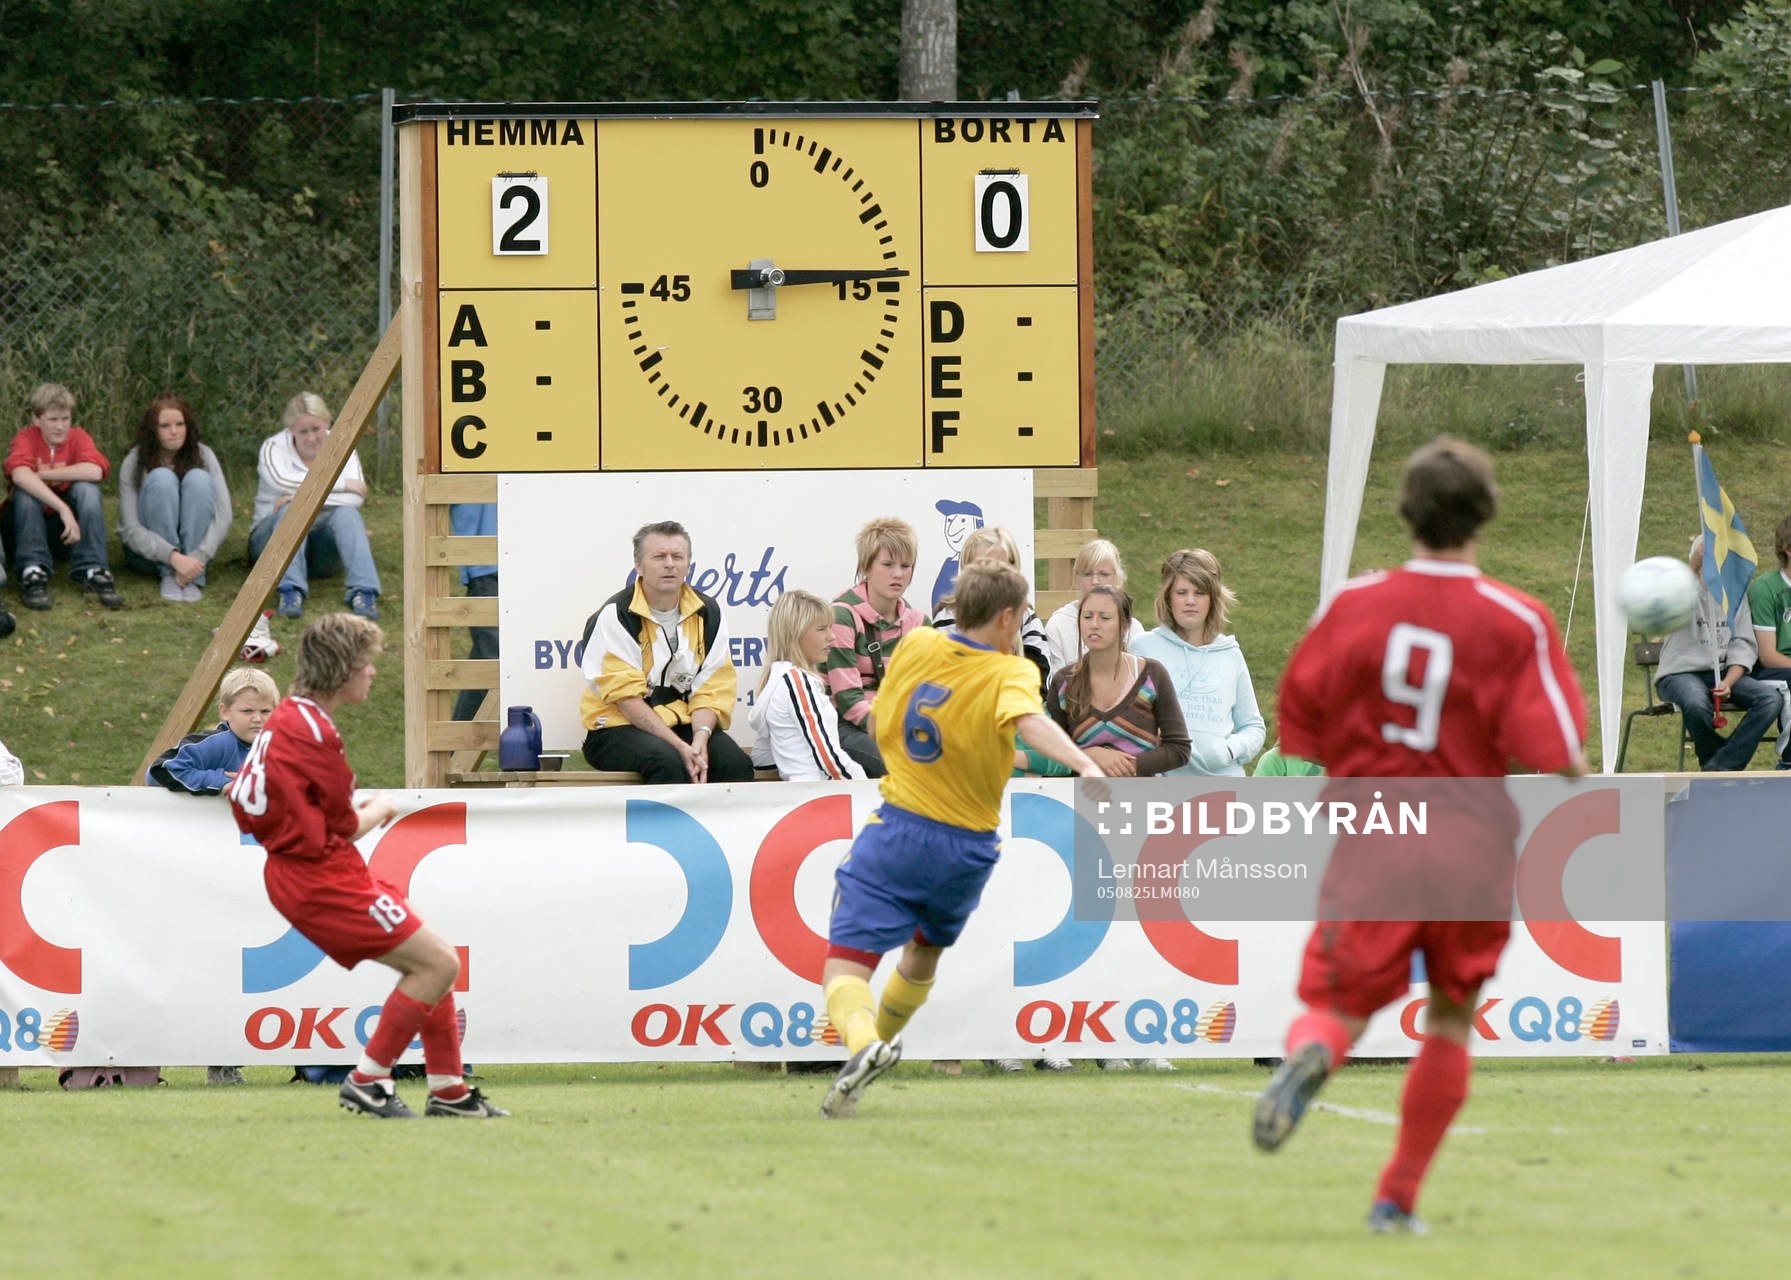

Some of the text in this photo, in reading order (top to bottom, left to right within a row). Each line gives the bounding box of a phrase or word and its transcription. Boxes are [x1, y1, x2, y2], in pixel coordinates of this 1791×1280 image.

[447, 119, 585, 146] HEMMA
[934, 118, 1066, 143] BORTA
[749, 161, 770, 188] 0
[499, 184, 541, 252] 2
[980, 180, 1023, 249] 0
[649, 274, 691, 302] 45
[831, 278, 872, 301] 15
[447, 304, 489, 348] A
[930, 300, 965, 343] D
[451, 359, 487, 403] B
[931, 355, 963, 398] E
[742, 386, 783, 414] 30
[450, 414, 488, 459] C
[932, 410, 961, 453] F
[746, 689, 755, 706] 1
[1381, 622, 1455, 754] 9
[904, 681, 953, 765] 6
[368, 894, 408, 934] 18
